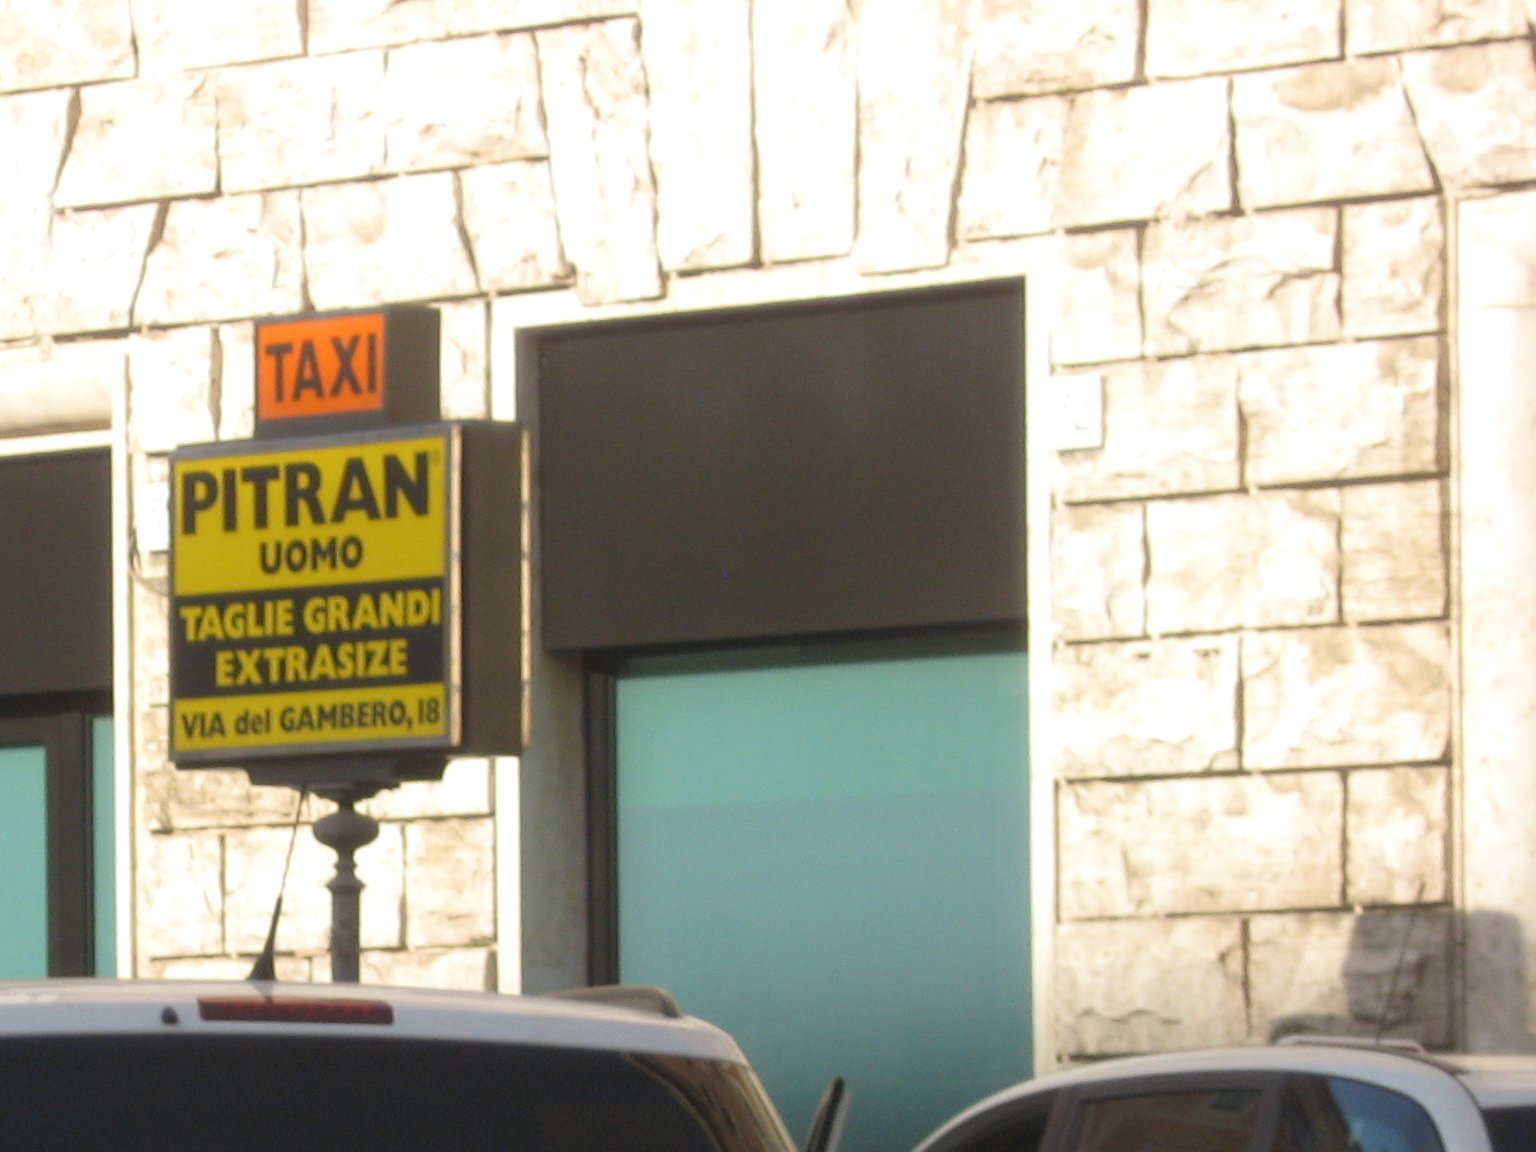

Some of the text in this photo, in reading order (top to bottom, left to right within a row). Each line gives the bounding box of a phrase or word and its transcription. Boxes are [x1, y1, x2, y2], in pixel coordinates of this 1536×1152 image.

[265, 332, 380, 403] TAXI
[181, 450, 431, 536] PITRAN
[258, 535, 364, 575] UOMO
[180, 588, 443, 643] TAGLIE GRANDI
[214, 638, 408, 688] EXTRASIZE
[181, 697, 441, 740] VIA del GAMBERO, 18
